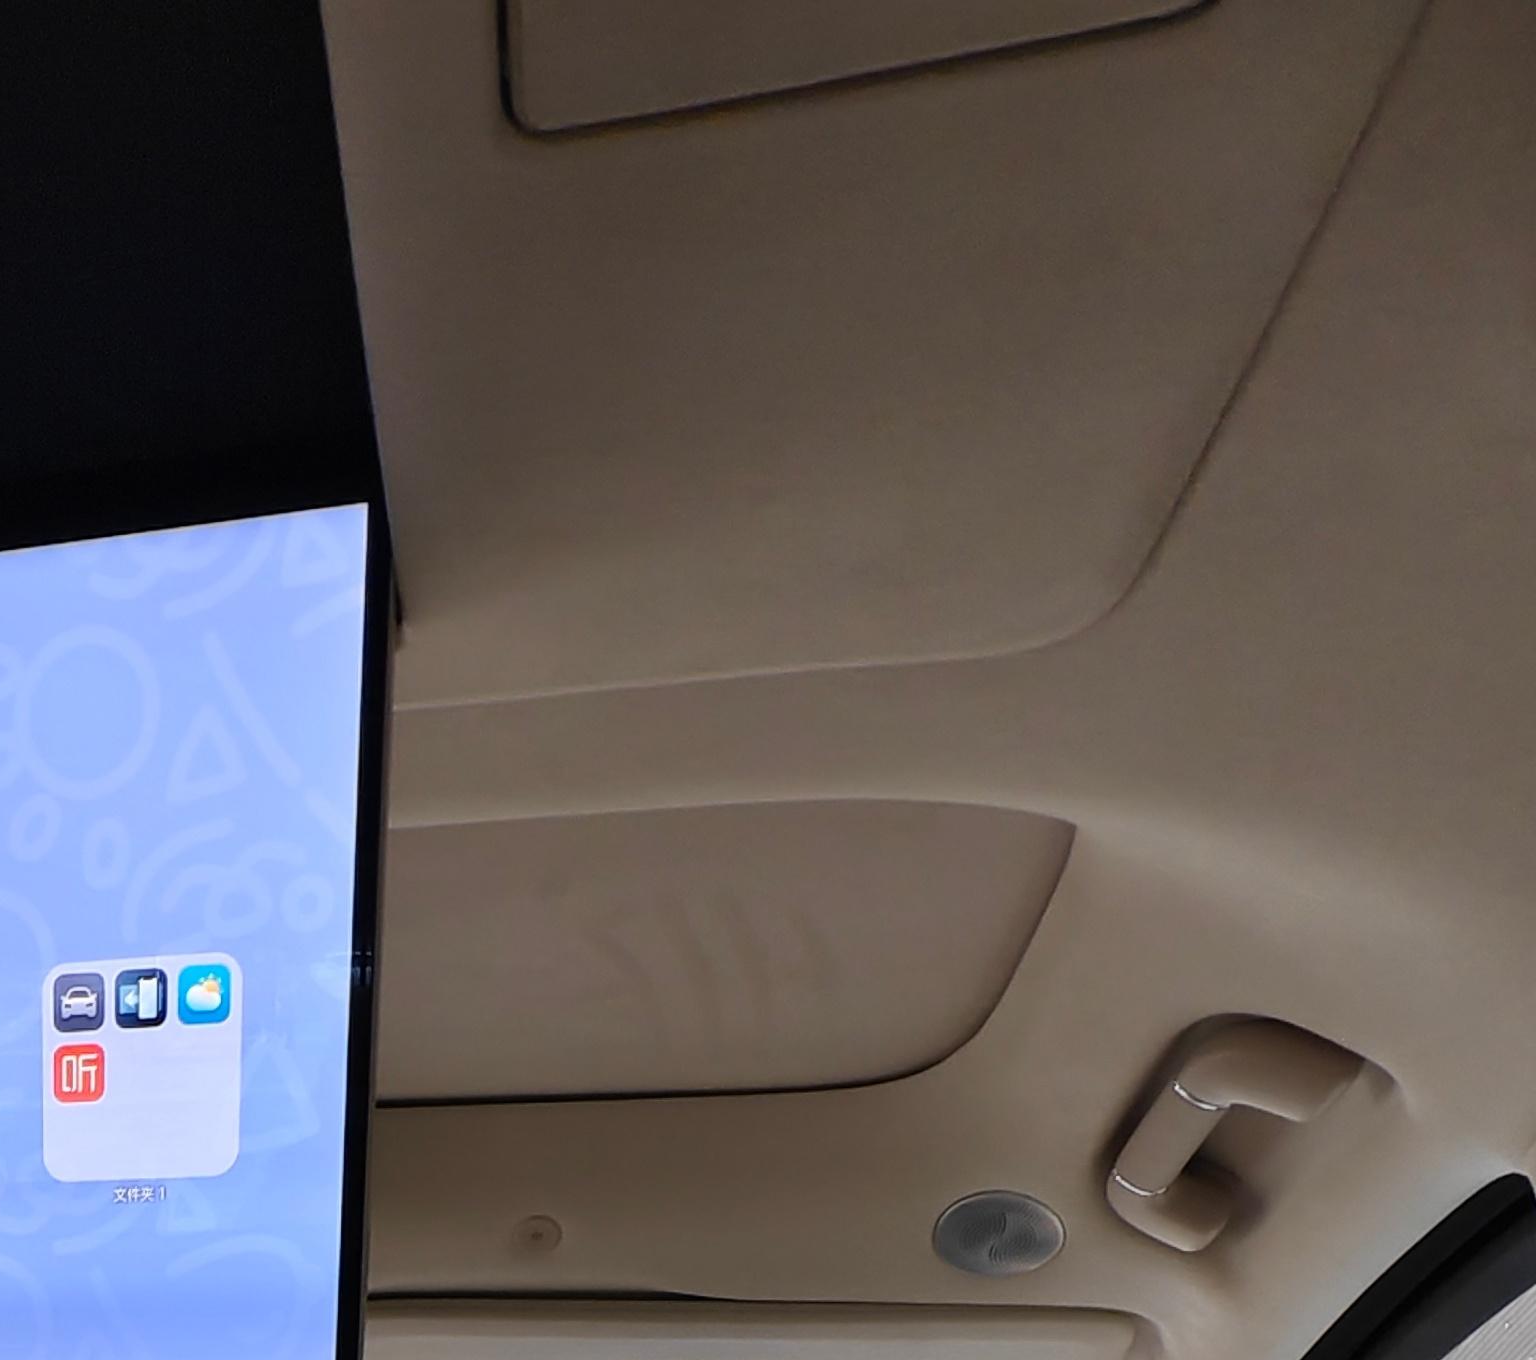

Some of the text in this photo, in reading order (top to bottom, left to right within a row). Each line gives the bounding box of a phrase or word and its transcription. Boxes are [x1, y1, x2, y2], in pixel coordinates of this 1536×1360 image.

[61, 1053, 98, 1093] 听
[114, 1187, 154, 1203] 文件夹
